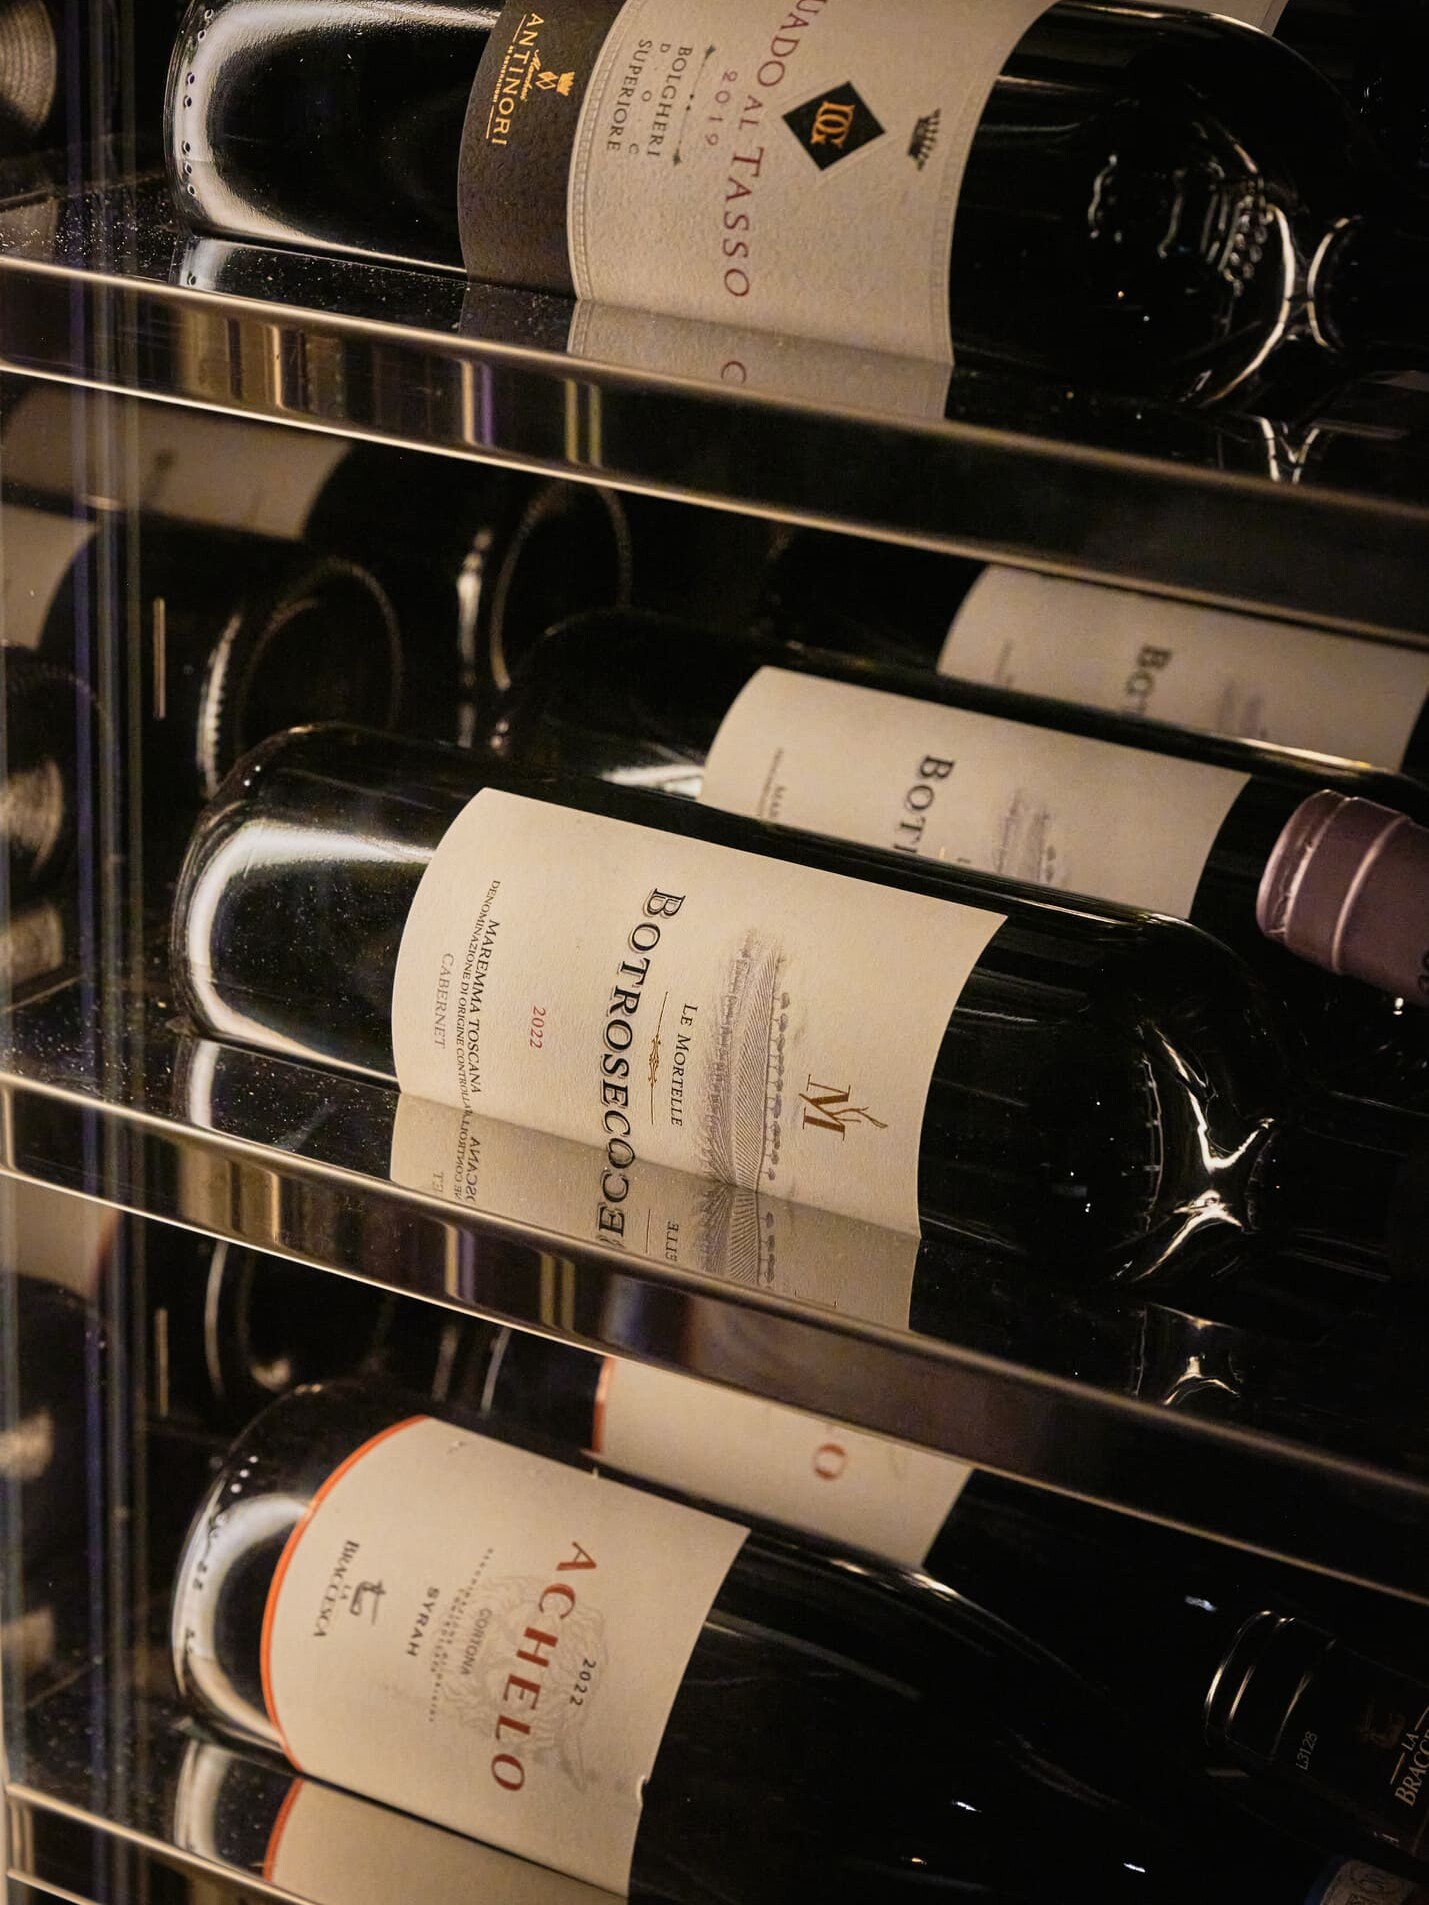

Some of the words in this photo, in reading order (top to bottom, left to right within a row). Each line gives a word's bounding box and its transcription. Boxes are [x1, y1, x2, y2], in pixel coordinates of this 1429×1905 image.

[491, 12, 545, 146] ANTINORI
[606, 39, 653, 152] SUPERIORE
[646, 46, 694, 157] BOLGHERI
[705, 70, 738, 146] 2019
[738, 95, 764, 130] AL
[722, 146, 765, 297] TASSO
[461, 879, 501, 980] DENOMINAZIONE
[469, 919, 501, 1014] MAREMMA
[433, 952, 455, 1050] CABERNET
[456, 996, 468, 1046] ORIGINE
[459, 981, 470, 996] DI
[680, 1003, 699, 1026] LE
[466, 1018, 482, 1094] TOSCANA
[529, 1005, 546, 1050] 2022
[669, 1033, 692, 1127] MORTELLE
[406, 1586, 440, 1657] SYRAH
[459, 1607, 492, 1677] CORTONA
[490, 1541, 597, 1793] ACHELO
[569, 1657, 597, 1707] 2022
[1295, 1731, 1318, 1771] L3128
[1401, 1732, 1420, 1751] LA
